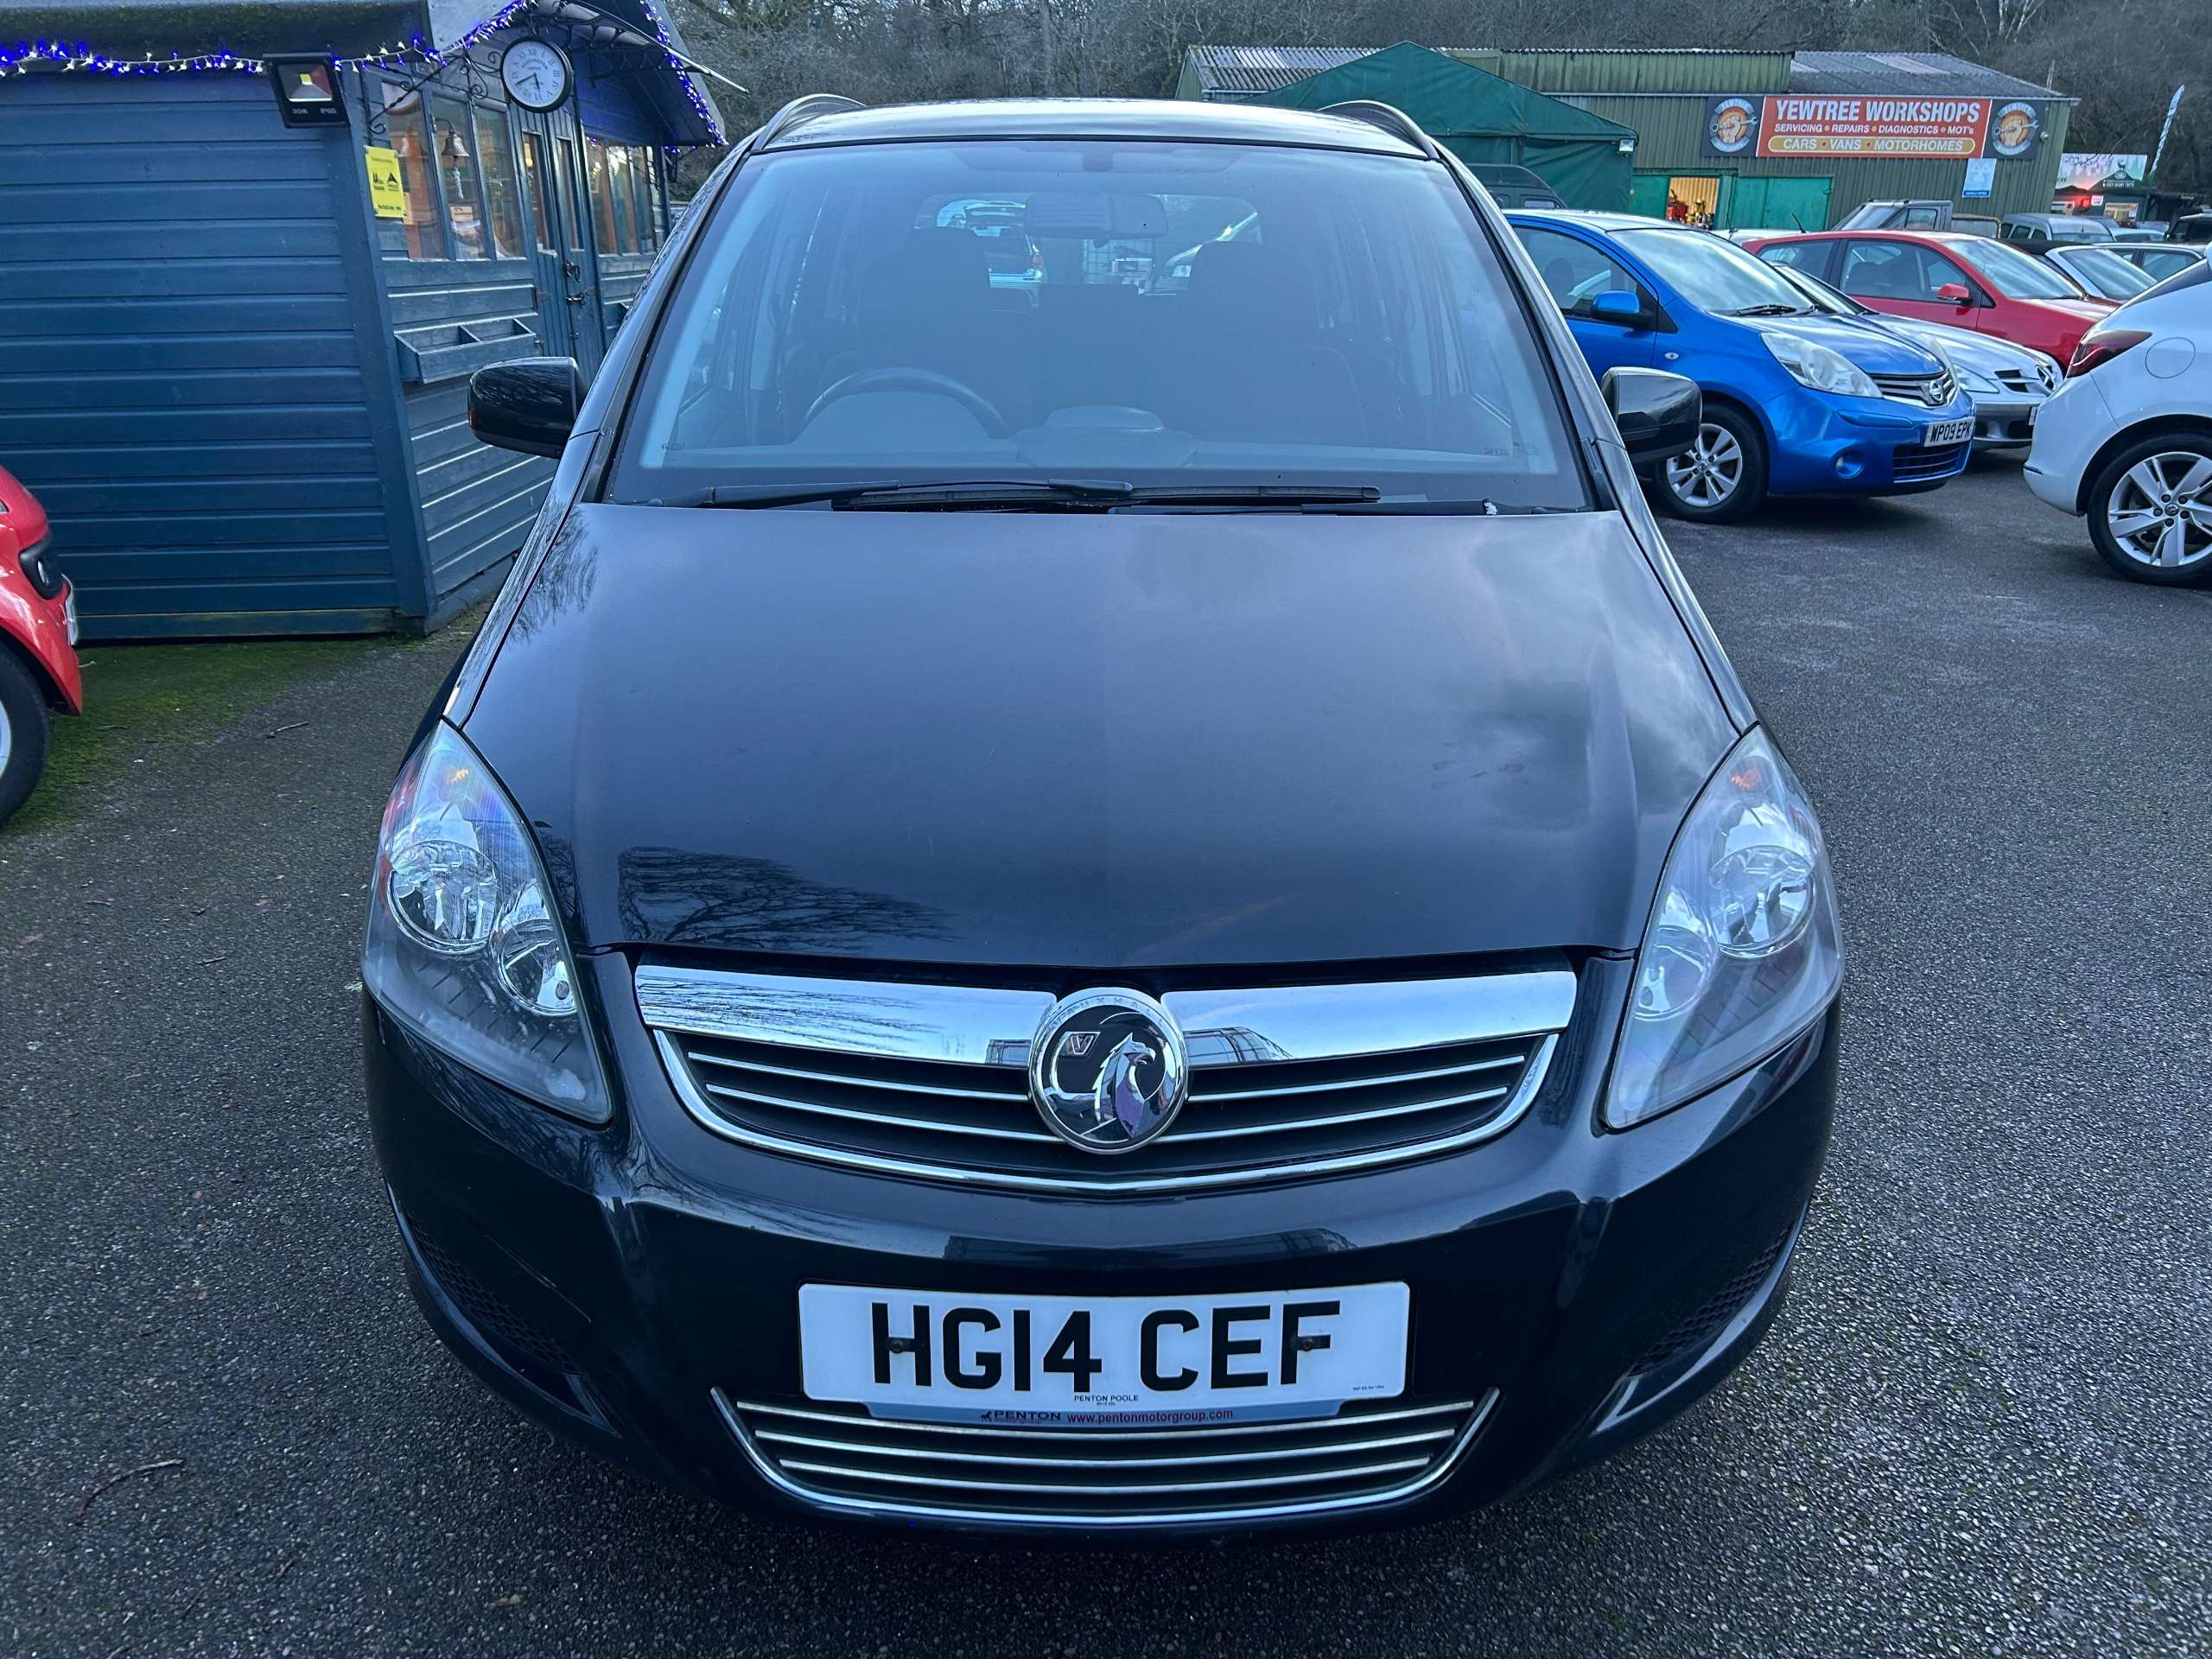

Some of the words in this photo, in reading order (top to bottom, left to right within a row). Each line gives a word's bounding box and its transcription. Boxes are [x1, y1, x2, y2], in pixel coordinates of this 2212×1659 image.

[1776, 99, 1861, 120] YEWTREE
[1866, 100, 1980, 123] WORKSHOPS
[1774, 124, 1822, 132] SERVICING
[1831, 124, 1869, 133] REPAIRS
[1878, 124, 1938, 134] DIAGNOSTICS
[1783, 138, 1817, 149] CARS
[1829, 138, 1861, 149] VANS
[1874, 139, 1963, 151] MOTORHOMES
[1929, 423, 1956, 442] WP09
[872, 1302, 1103, 1392] HG14
[1141, 1300, 1340, 1391] CEF
[995, 1409, 1061, 1421] PENTON
[1067, 1409, 1233, 1425] www.pentonmotorgroup.com
